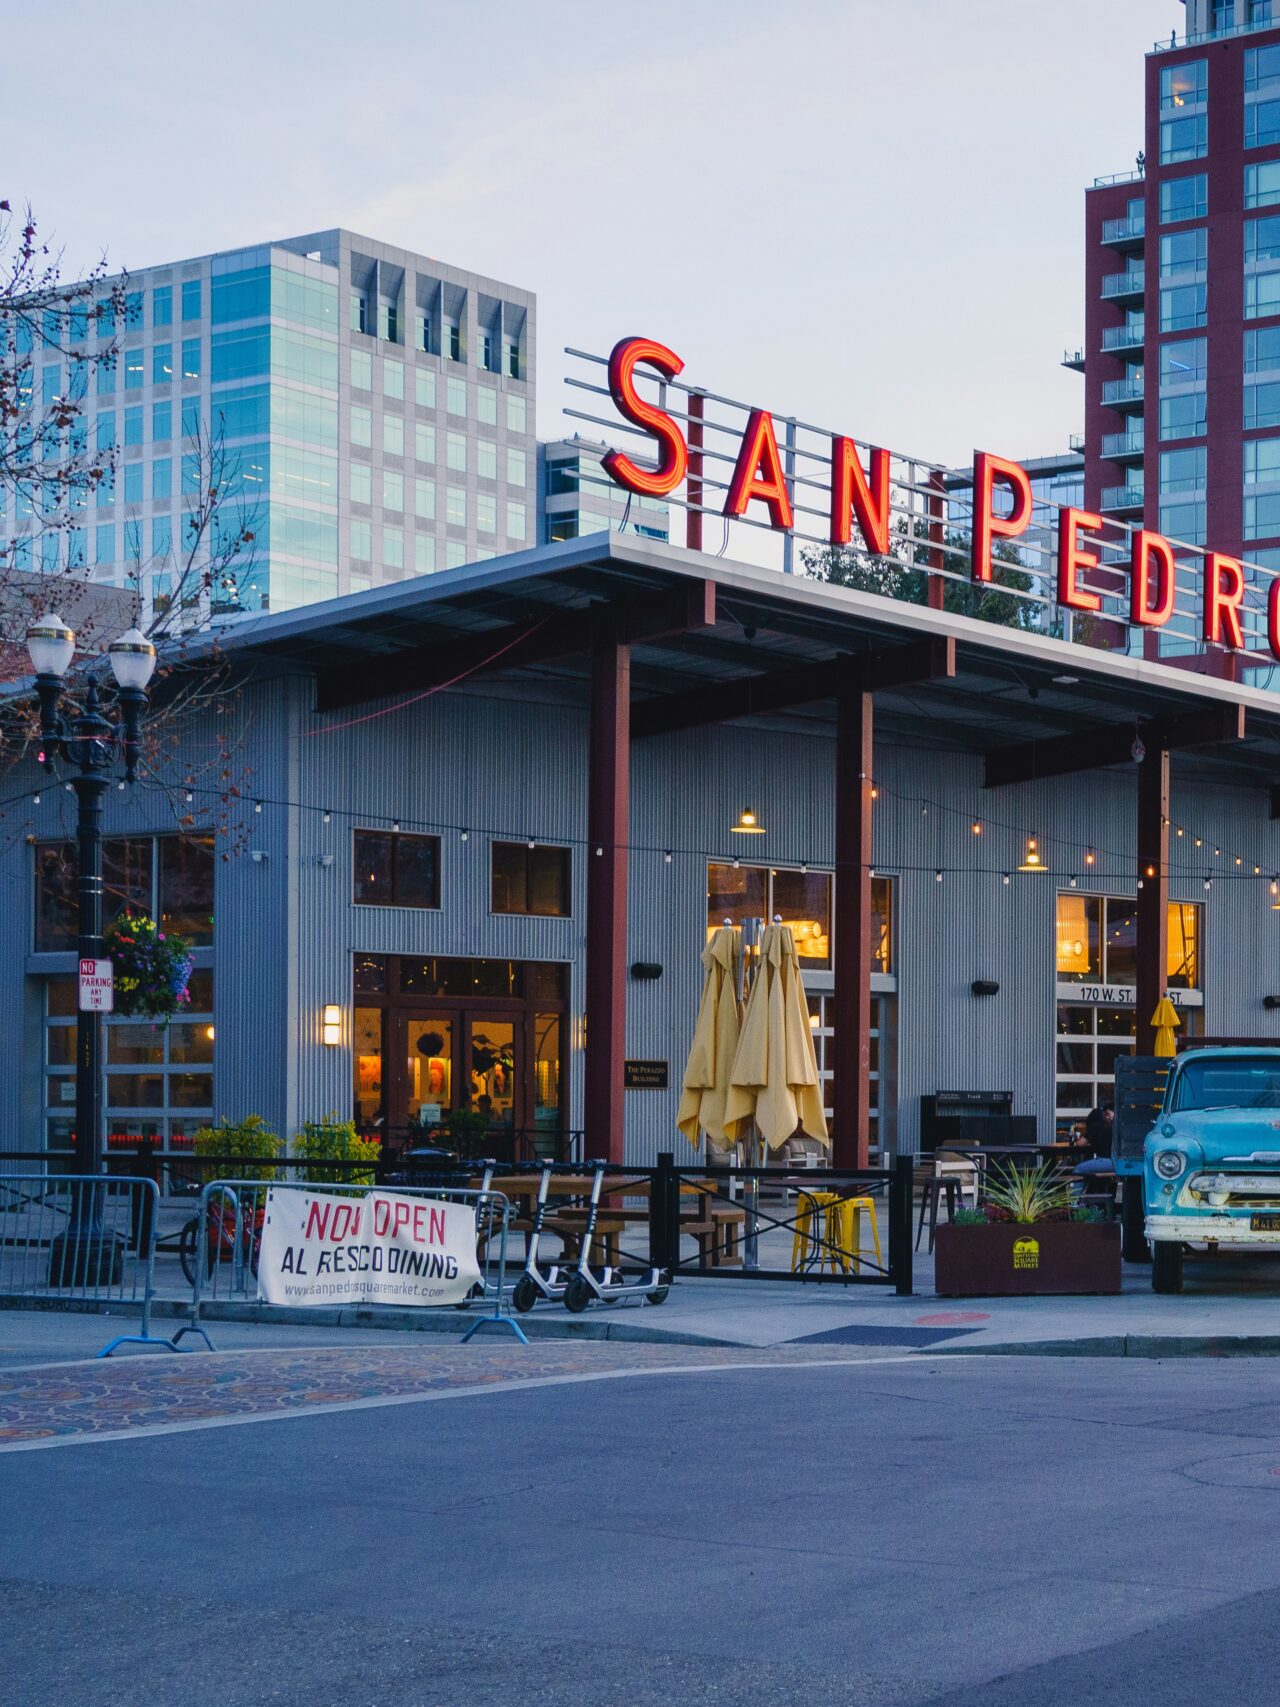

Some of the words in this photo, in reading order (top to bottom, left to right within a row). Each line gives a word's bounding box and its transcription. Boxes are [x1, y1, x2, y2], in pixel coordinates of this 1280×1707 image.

[600, 336, 893, 555] SAN
[82, 961, 94, 974] NO
[82, 977, 112, 988] PARKING
[90, 997, 102, 1005] TIME
[1080, 987, 1099, 1001] 170
[1102, 988, 1115, 1001] W.
[1118, 989, 1133, 1002] ST.
[374, 1199, 446, 1246] OPEN
[280, 1246, 307, 1275] AL
[388, 1247, 458, 1280] DINING
